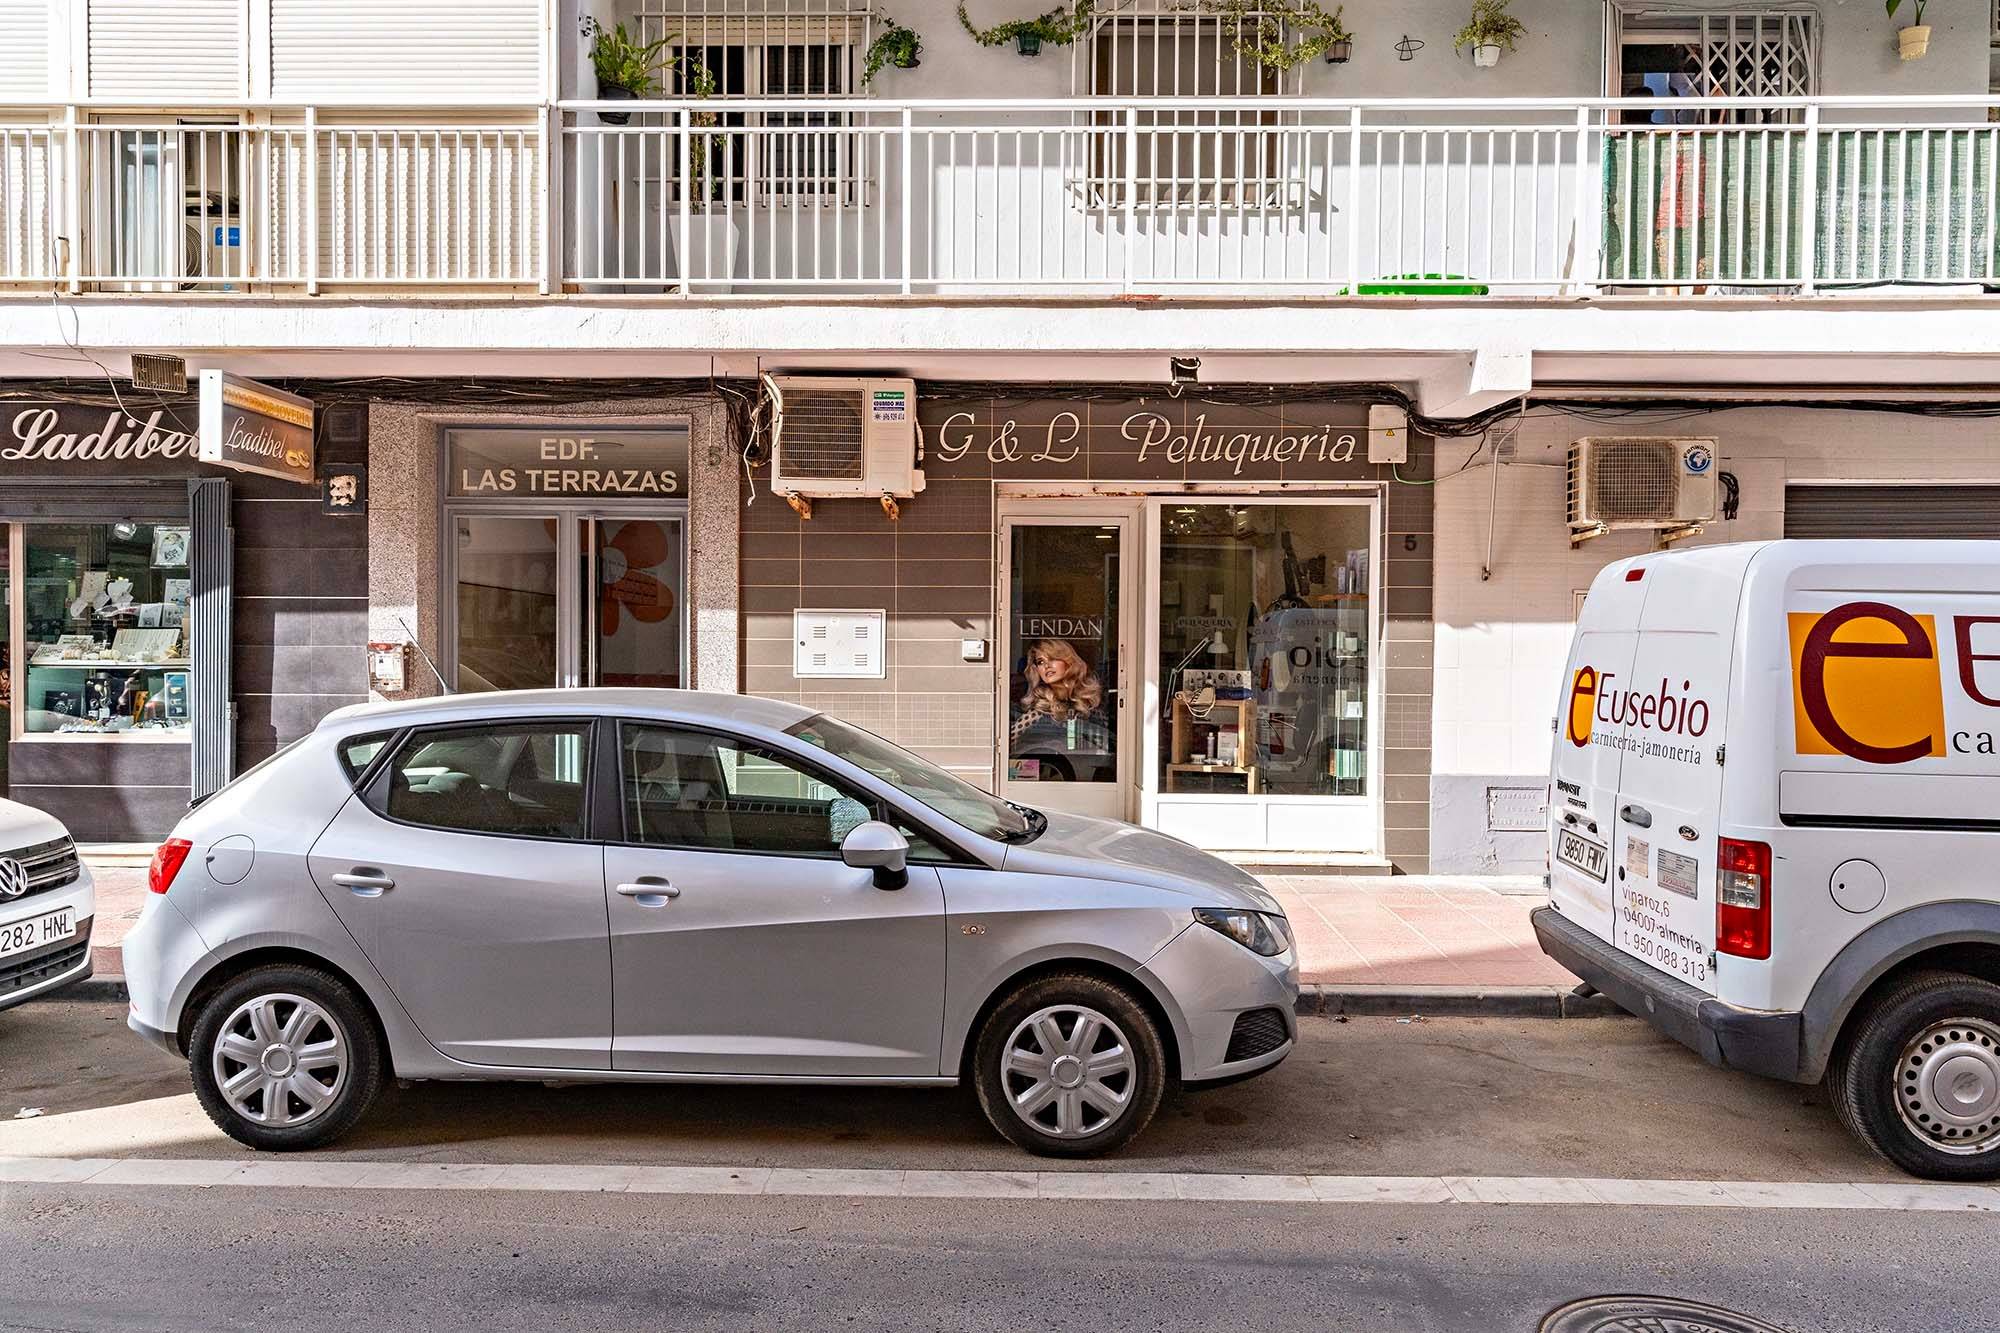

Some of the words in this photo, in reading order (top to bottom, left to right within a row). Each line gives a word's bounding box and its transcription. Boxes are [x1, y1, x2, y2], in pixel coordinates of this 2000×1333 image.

[225, 416, 288, 459] Ladibel
[540, 438, 600, 460] EDF.
[937, 412, 976, 463] G
[987, 420, 1023, 462] &
[1031, 412, 1081, 463] L
[462, 469, 517, 491] LAS
[525, 470, 678, 492] TERRAZAS
[1404, 534, 1417, 551] 5
[1020, 619, 1104, 636] LENDAN
[1800, 601, 1934, 764] e
[1597, 673, 1709, 737] Eusebio
[1591, 731, 1701, 765] carnicería-jamonería
[1952, 731, 1996, 755] ca
[1564, 836, 1585, 864] 9850
[0, 923, 35, 953] 282
[43, 913, 74, 941] HNL
[1633, 933, 1654, 957] 950
[1656, 945, 1678, 969] 088
[1681, 957, 1706, 982] 313
